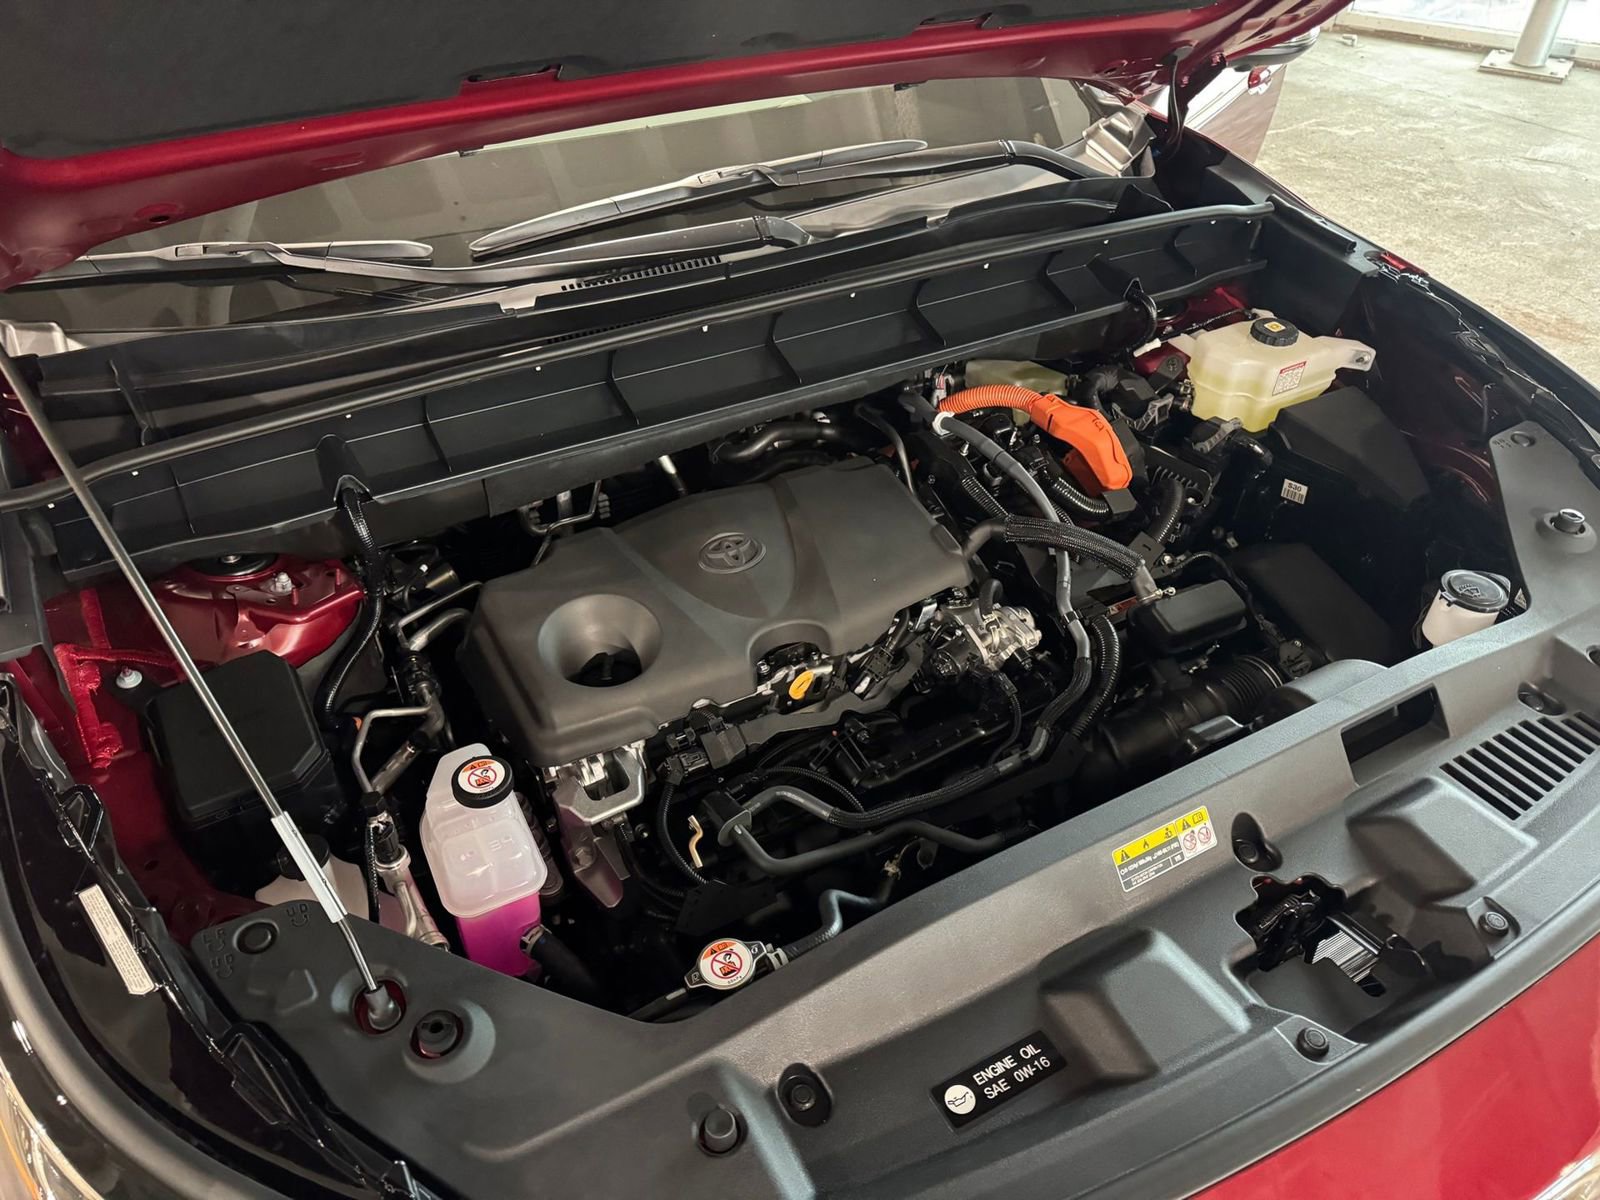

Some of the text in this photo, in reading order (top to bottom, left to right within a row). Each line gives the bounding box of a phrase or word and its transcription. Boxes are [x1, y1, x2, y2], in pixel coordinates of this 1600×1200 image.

[972, 1043, 1042, 1086] ENGINE OIL
[983, 1056, 1051, 1100] SAE 0W-16
